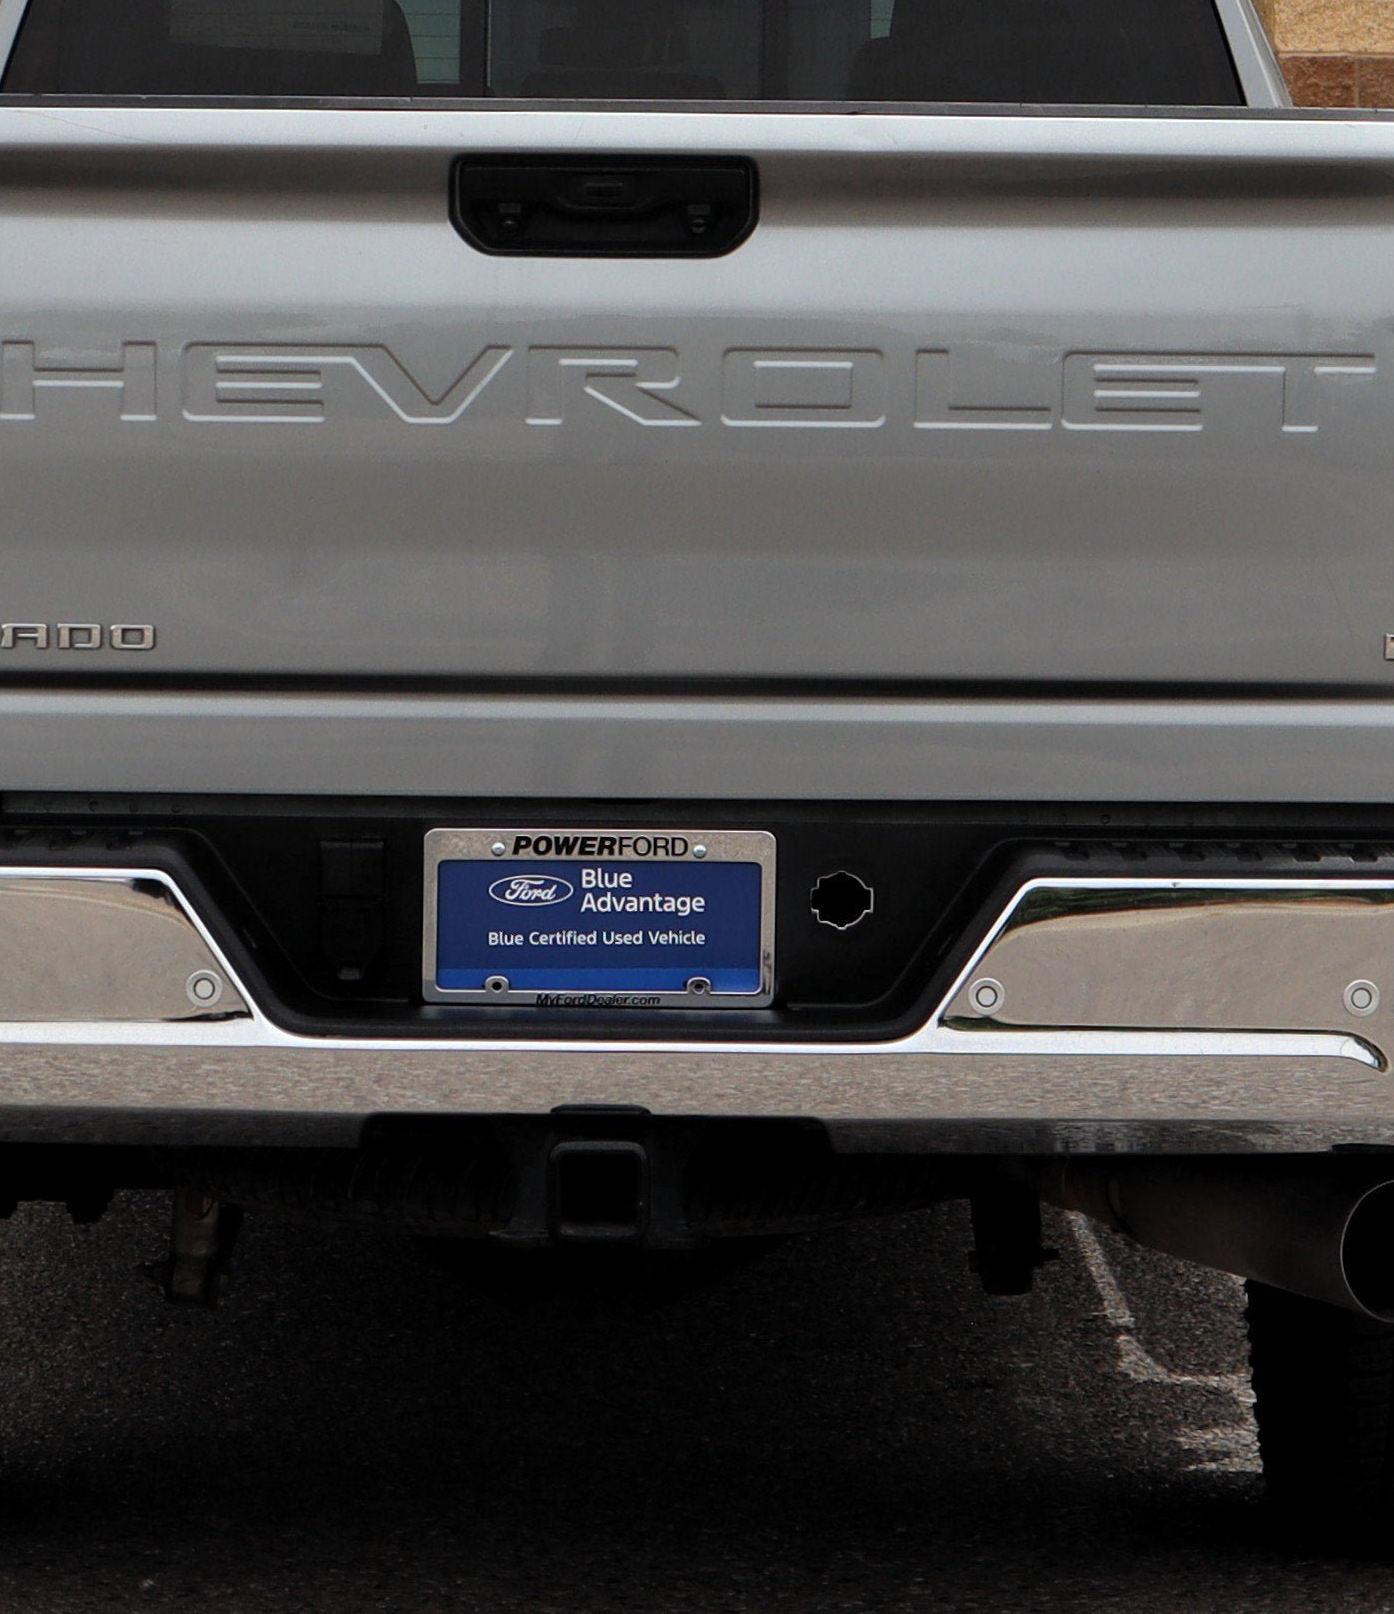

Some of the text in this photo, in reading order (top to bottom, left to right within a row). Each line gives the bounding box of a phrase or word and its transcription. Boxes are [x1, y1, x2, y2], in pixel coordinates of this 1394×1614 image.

[512, 835, 689, 857] POWERFORD
[581, 868, 633, 889] Blue
[504, 879, 558, 902] Ford
[580, 891, 706, 916] Advantage
[488, 930, 706, 946] Blue Certified Used Vehicle
[535, 993, 661, 1007] MyFordDealer.com
